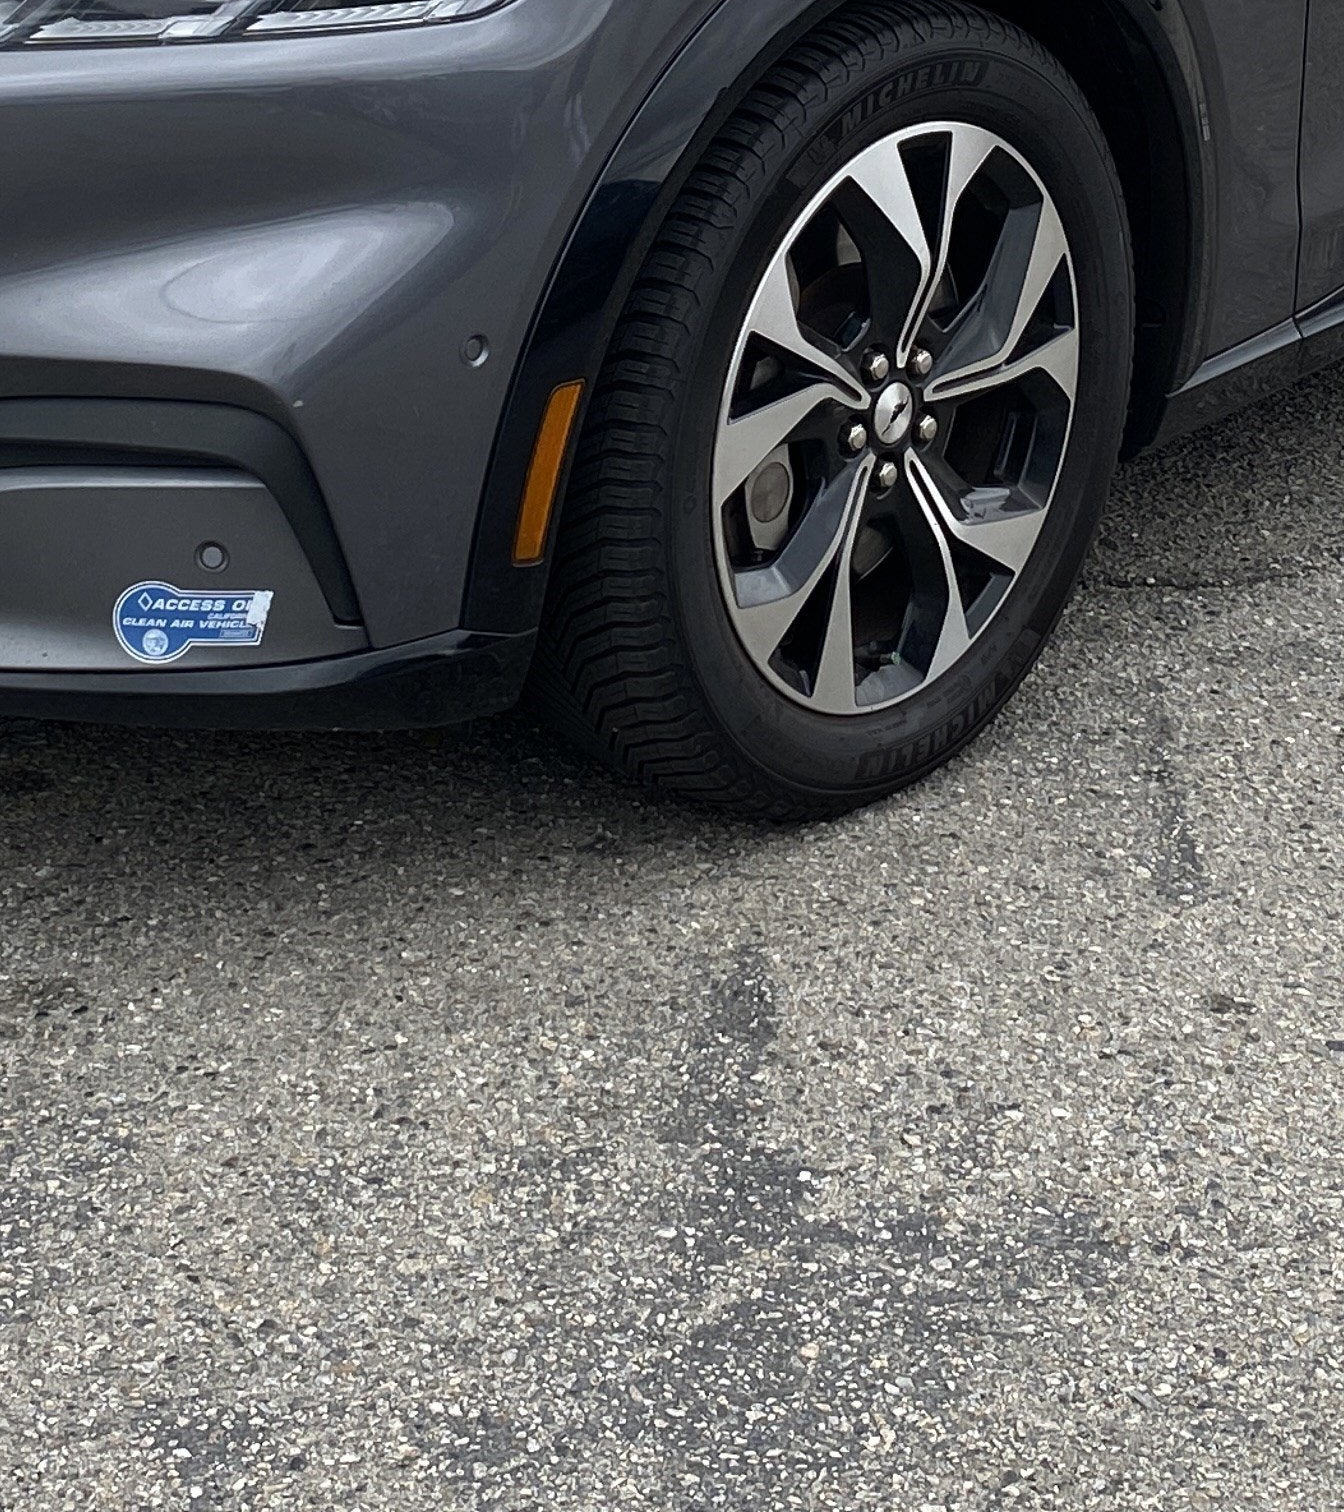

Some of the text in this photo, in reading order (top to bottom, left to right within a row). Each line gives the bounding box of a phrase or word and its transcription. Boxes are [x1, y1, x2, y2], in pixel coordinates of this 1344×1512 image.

[842, 60, 984, 137] MICHELIN
[151, 598, 226, 611] ACCESS
[122, 617, 253, 629] CLEAN AIR VEHICL
